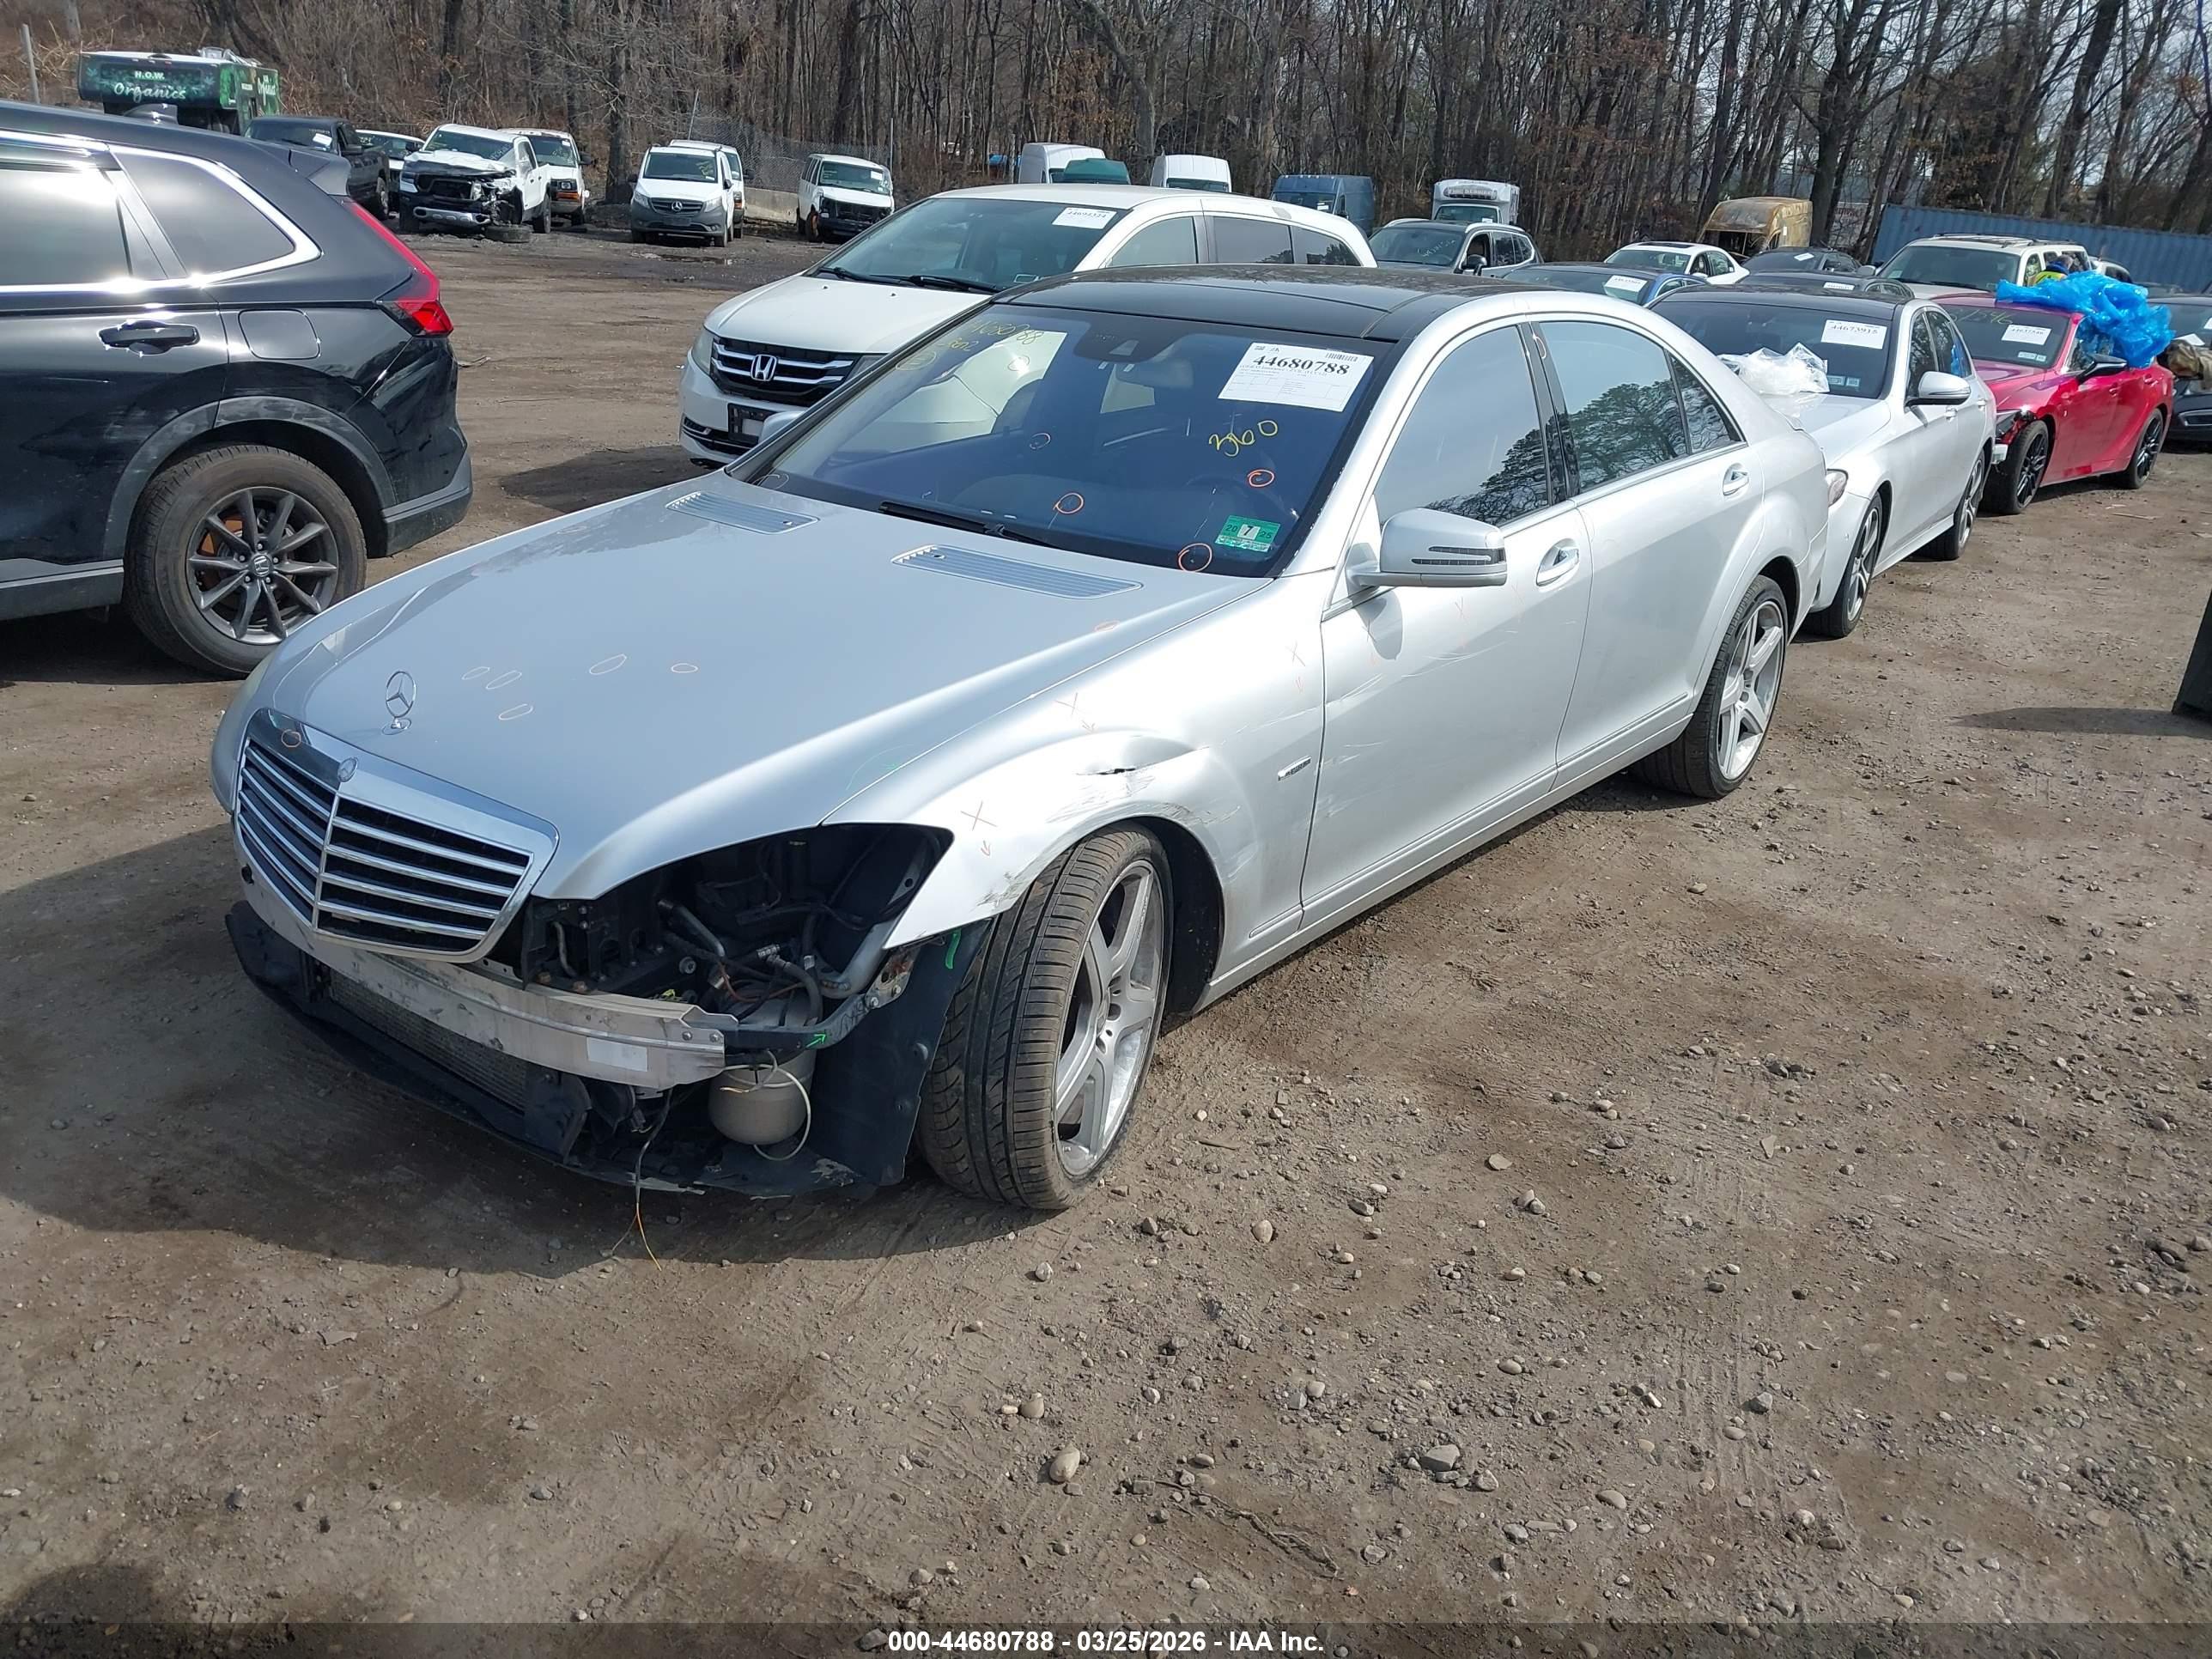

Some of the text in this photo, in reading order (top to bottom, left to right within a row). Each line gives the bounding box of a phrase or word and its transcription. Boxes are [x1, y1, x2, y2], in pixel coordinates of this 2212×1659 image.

[134, 70, 166, 81] H.O.W.
[113, 82, 186, 102] Organics
[1253, 355, 1350, 375] 44680788
[1225, 524, 1272, 539] 20 7 25
